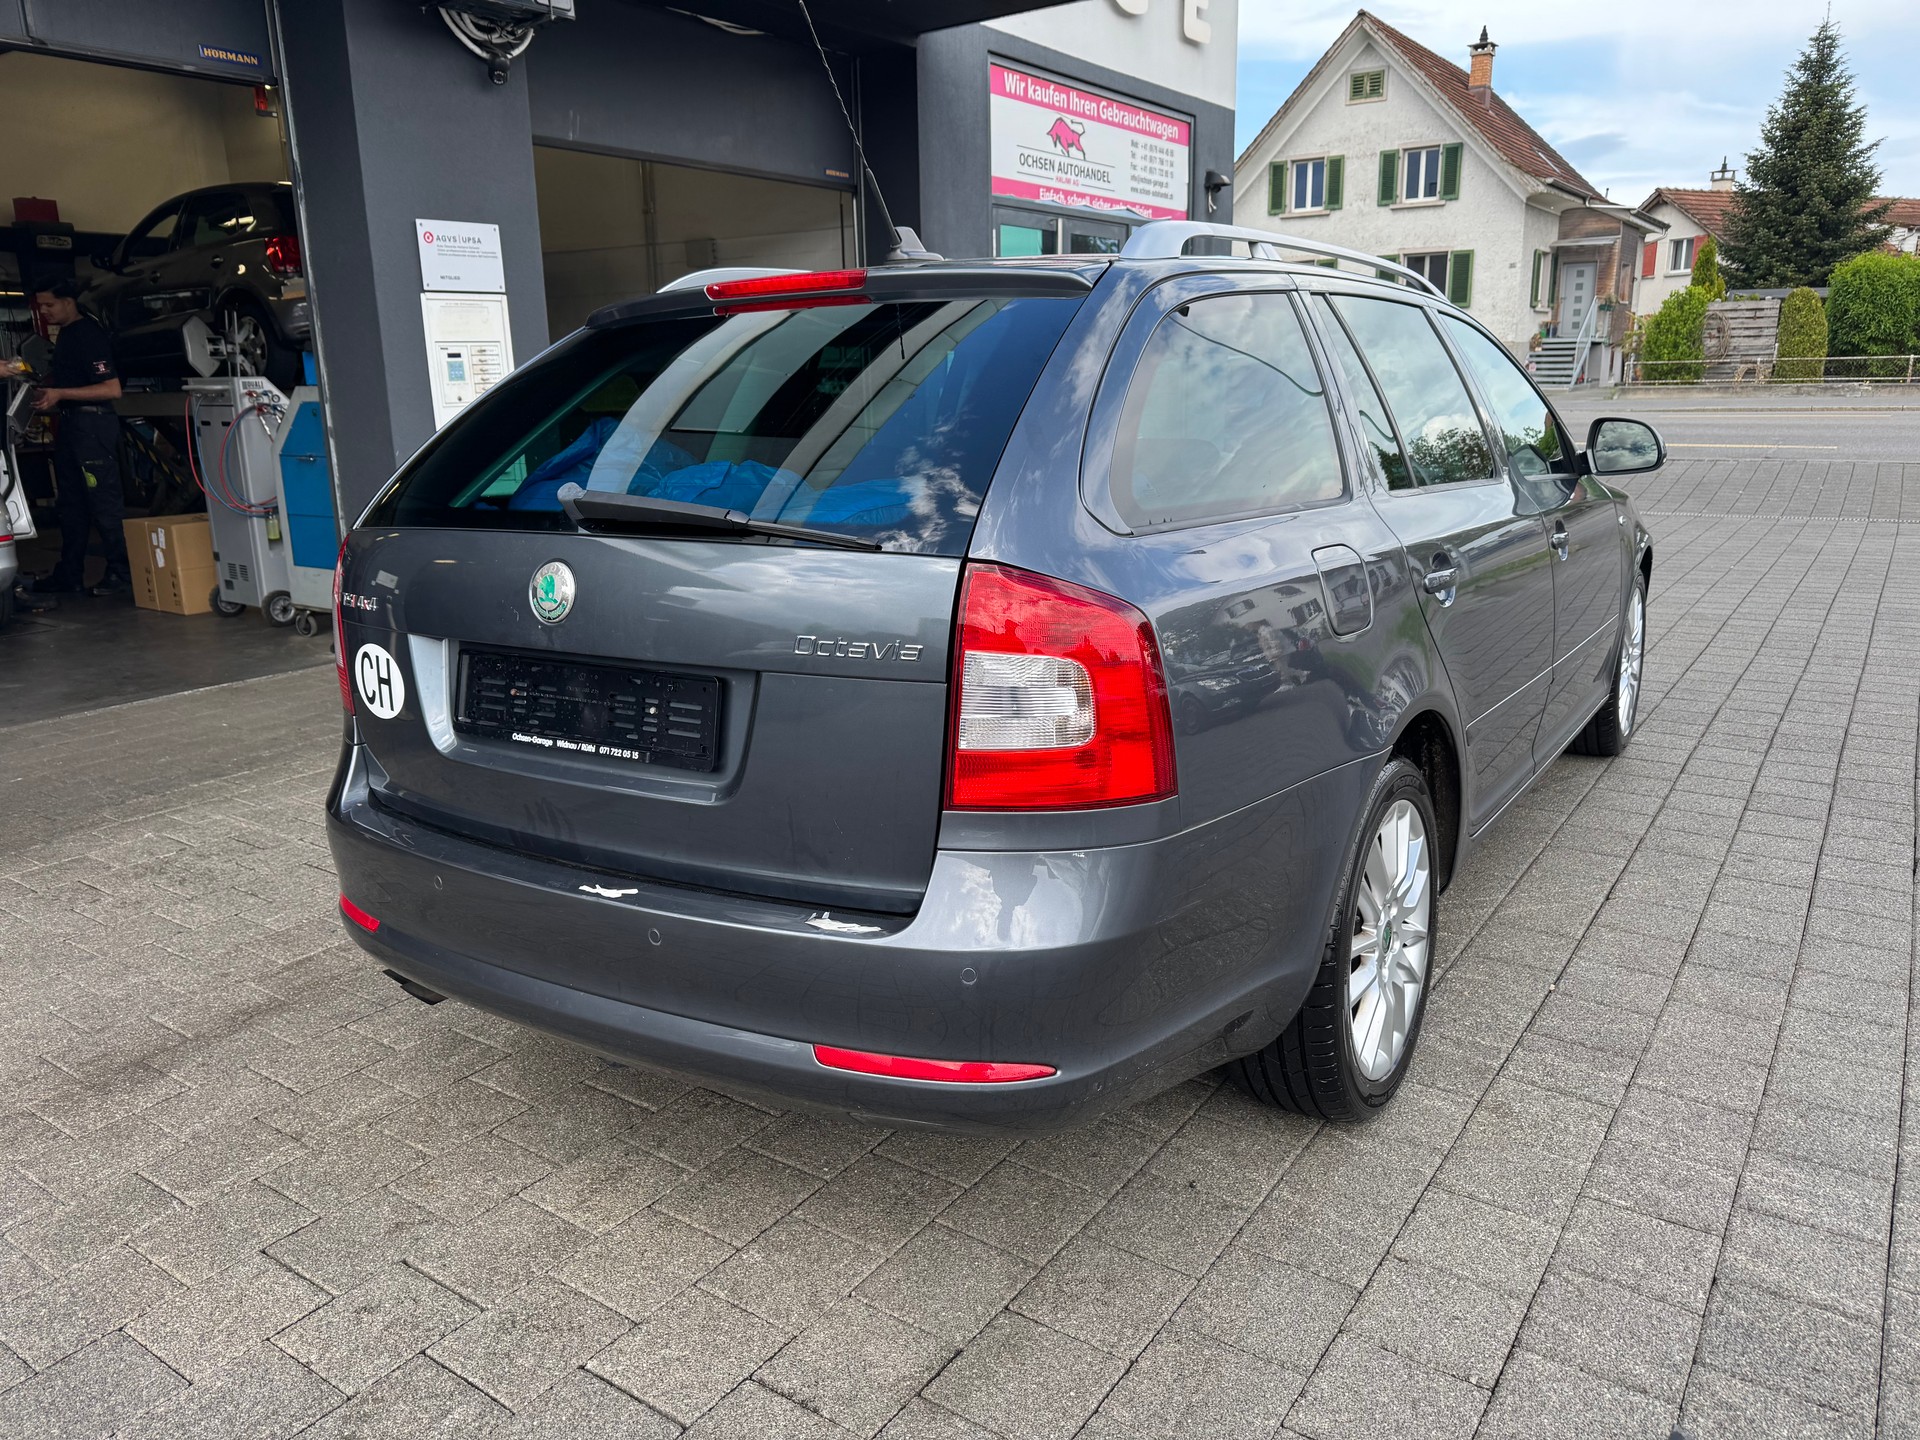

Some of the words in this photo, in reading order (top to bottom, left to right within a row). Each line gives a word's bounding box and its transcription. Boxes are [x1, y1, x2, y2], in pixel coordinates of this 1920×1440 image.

[1004, 71, 1026, 97] Wir
[1027, 78, 1068, 109] kaufen
[1069, 91, 1098, 117] Ihren
[1099, 100, 1179, 140] Gebrauchtwagen
[1019, 152, 1056, 172] OCHSEN
[1057, 160, 1111, 184] AUTOHANDEL
[436, 234, 458, 244] AGVS
[461, 236, 482, 245] UPSA
[793, 635, 924, 661] Octavia
[361, 651, 395, 712] CH
[512, 732, 553, 747] Ochsen-Garage
[556, 739, 577, 750] Widnau
[599, 746, 610, 755] 071
[610, 747, 622, 757] 722
[622, 750, 631, 759] 05
[631, 751, 639, 760] 15
